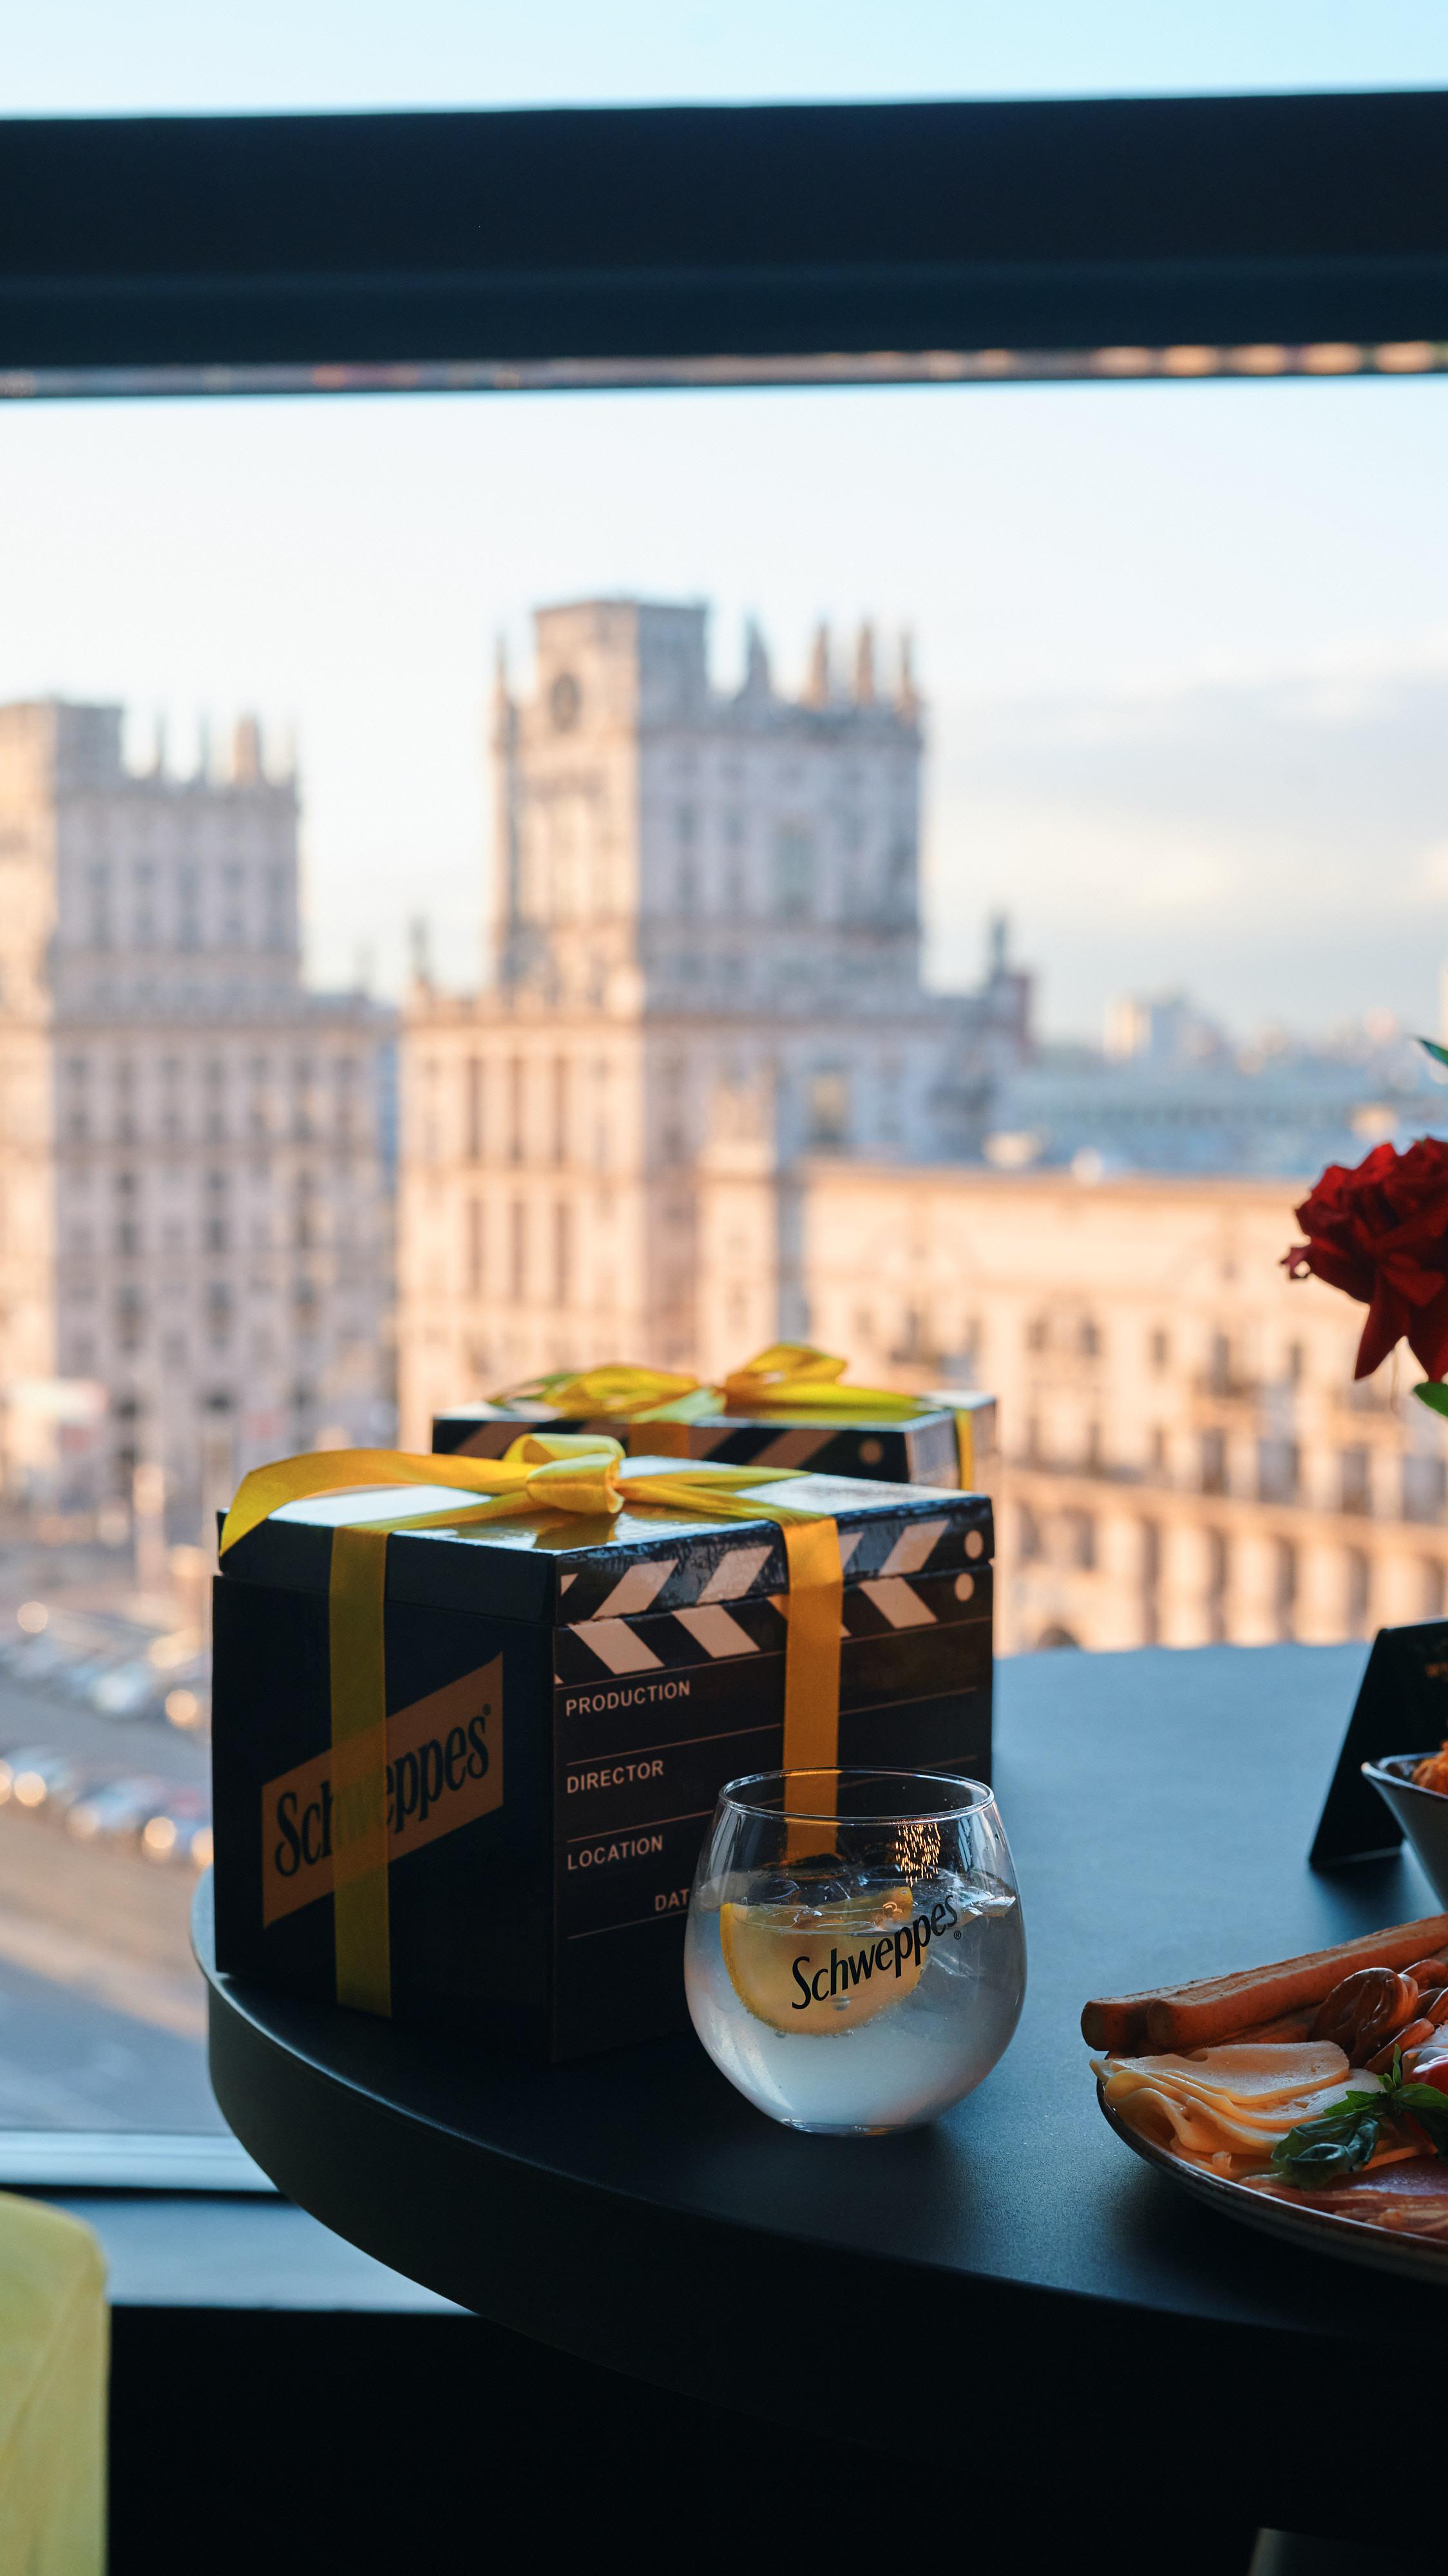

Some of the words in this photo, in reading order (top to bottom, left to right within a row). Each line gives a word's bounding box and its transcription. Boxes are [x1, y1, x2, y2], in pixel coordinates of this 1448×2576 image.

[566, 1680, 691, 1717] PRODUCTION
[566, 1759, 664, 1794] DIRECTOR
[567, 1834, 663, 1871] LOCATION
[654, 1888, 691, 1912] DAT
[791, 1893, 958, 2010] Schweppes
